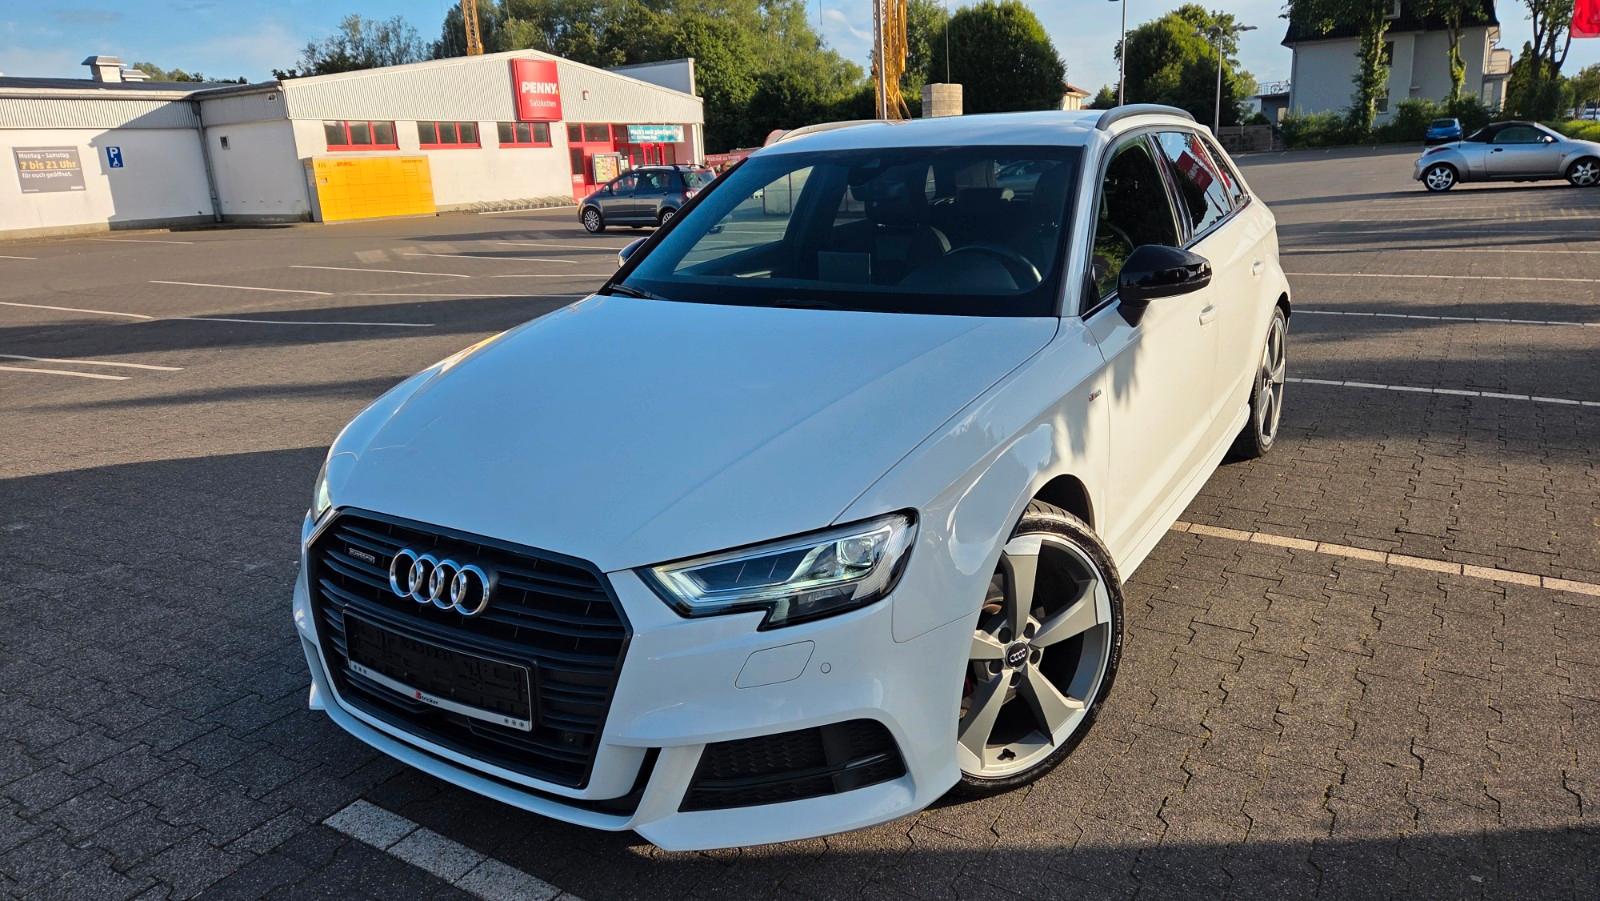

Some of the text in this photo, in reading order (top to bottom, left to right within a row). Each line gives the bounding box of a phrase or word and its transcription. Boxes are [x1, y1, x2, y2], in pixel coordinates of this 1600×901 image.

[110, 147, 119, 158] P
[20, 160, 76, 169] 7 bis 21 Uhr
